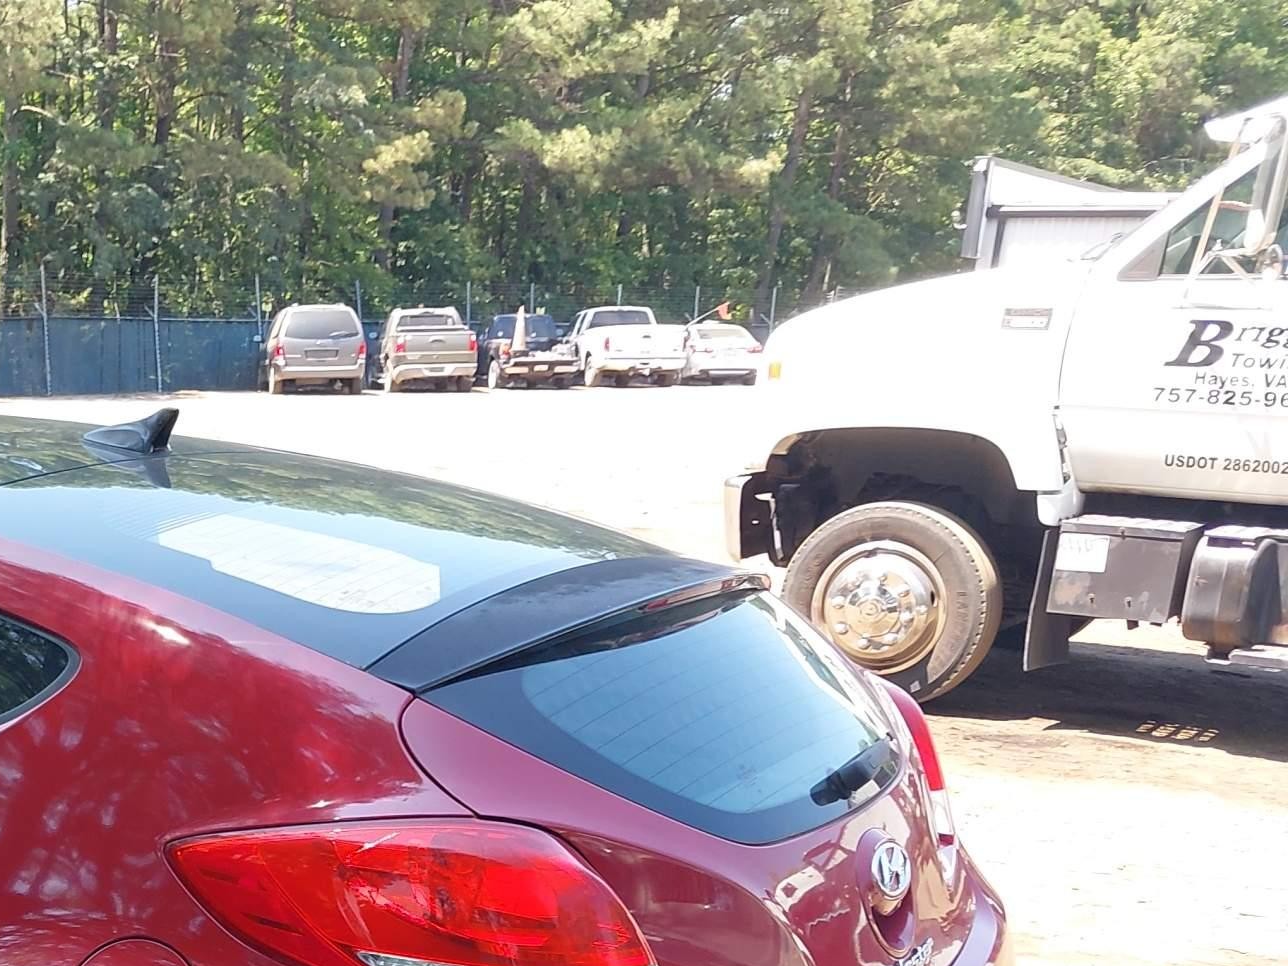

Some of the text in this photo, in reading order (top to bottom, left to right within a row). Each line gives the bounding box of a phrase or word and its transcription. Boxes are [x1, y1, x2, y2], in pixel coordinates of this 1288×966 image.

[1163, 319, 1288, 368] Brig
[1264, 373, 1288, 388] VA
[1164, 454, 1288, 475] USDOT 2862002
